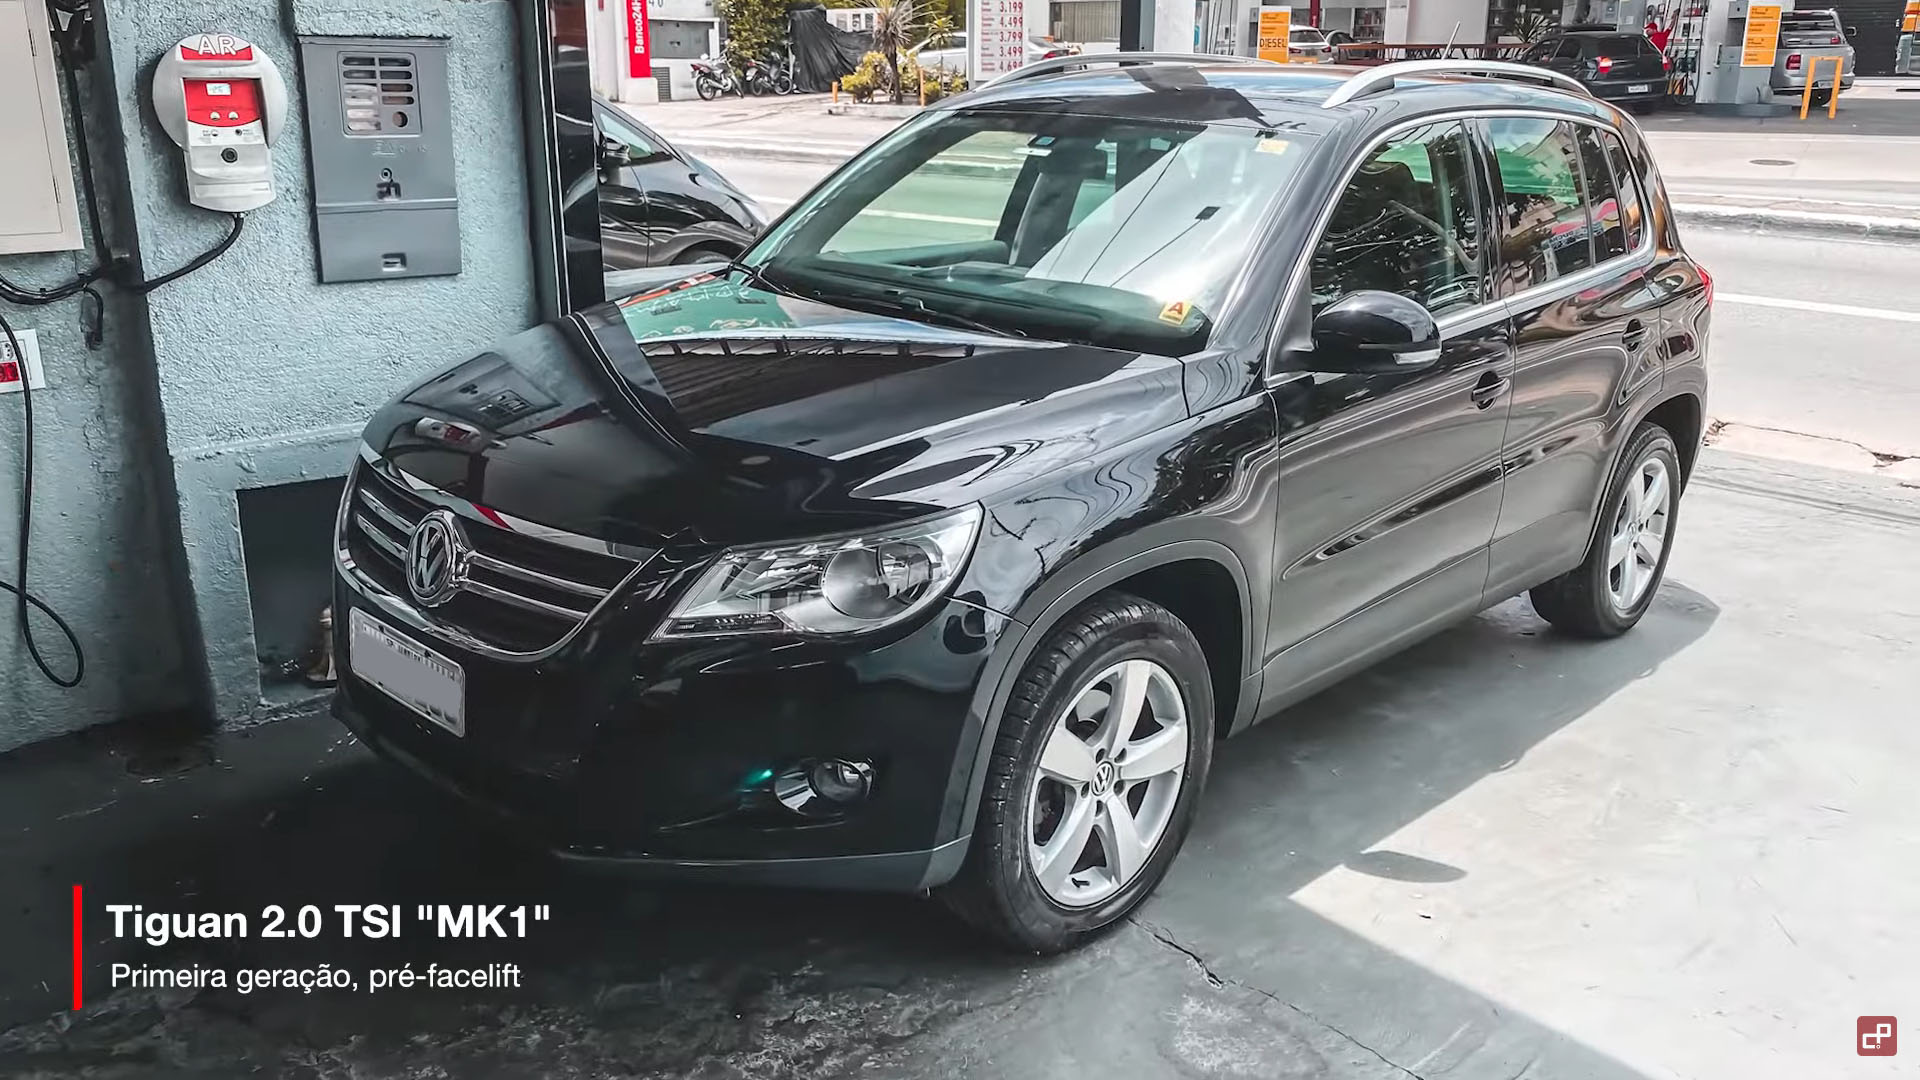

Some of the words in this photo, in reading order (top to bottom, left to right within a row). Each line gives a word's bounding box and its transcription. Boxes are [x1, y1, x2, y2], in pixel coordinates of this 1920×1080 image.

[999, 1, 1023, 13] 3.199
[999, 16, 1023, 28] 4.499
[999, 31, 1023, 42] 3.799
[198, 35, 237, 56] AR
[1259, 38, 1288, 48] DIESEL
[999, 46, 1023, 57] 3.499
[1168, 302, 1183, 315] A
